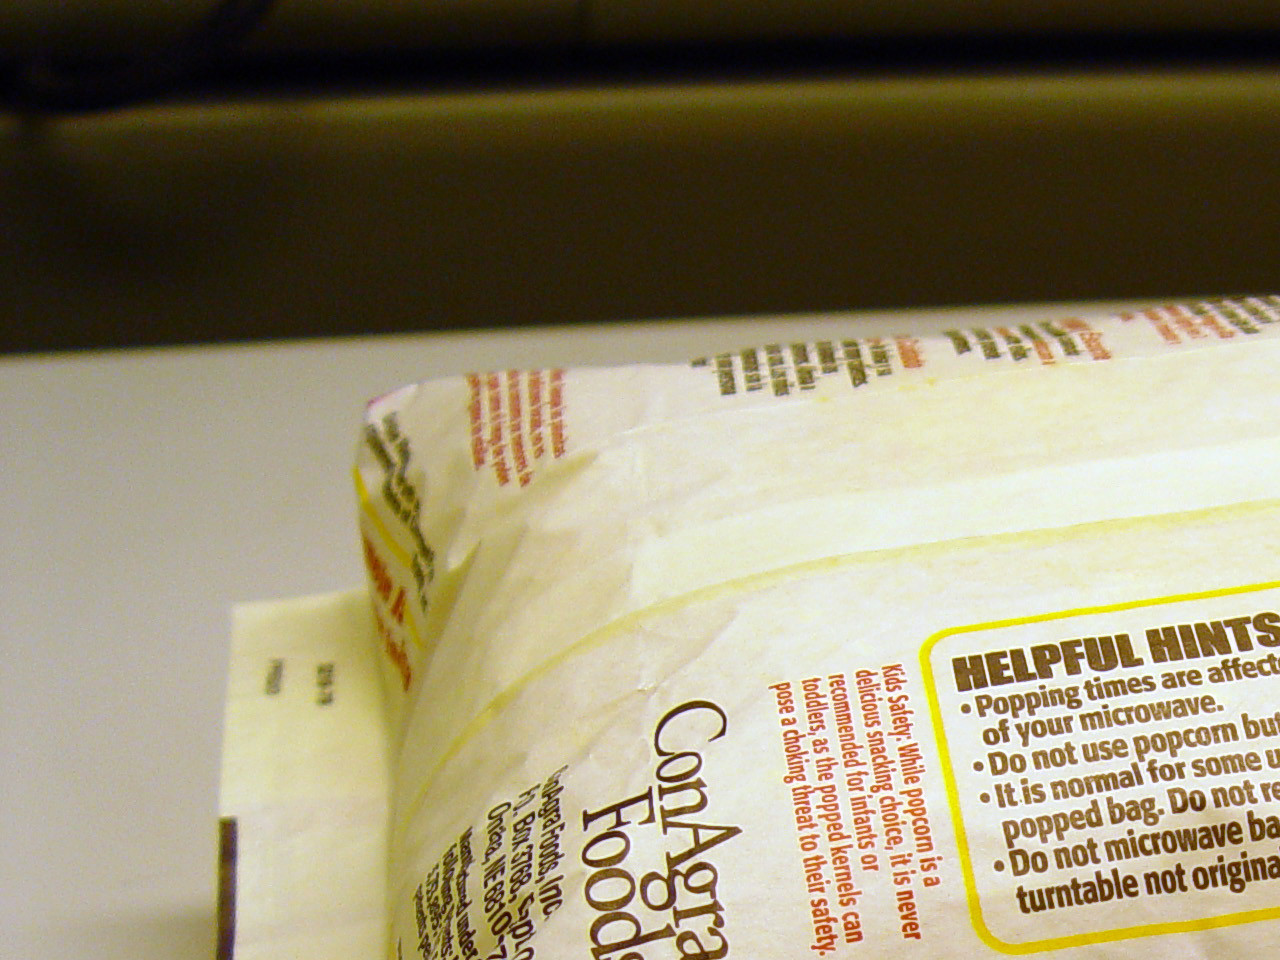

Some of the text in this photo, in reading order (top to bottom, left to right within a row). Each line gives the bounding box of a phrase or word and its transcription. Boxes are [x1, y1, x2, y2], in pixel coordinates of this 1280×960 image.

[952, 634, 1143, 691] HELPFUL
[975, 683, 1082, 719] Popping
[1083, 677, 1156, 702] times
[1161, 669, 1203, 690] are
[982, 693, 1224, 748] of your microwave.
[828, 673, 879, 871] recommended for infants or
[882, 663, 943, 887] Kids Safety: While popcorn is a
[988, 750, 1027, 776] Do
[1031, 739, 1078, 772] not
[1082, 735, 1128, 765] use
[1134, 723, 1240, 763] popcorn
[994, 782, 1018, 808] It
[1022, 779, 1046, 804] is
[1050, 762, 1143, 801] normal
[1146, 758, 1186, 784] for
[1191, 749, 1262, 779] some
[512, 810, 536, 852] Box
[768, 681, 839, 956] pose a choking threat to their safety.
[801, 677, 864, 943] toddlers, as the popped kernels can
[855, 669, 921, 940] delicious snacking choice, it is never
[1002, 802, 1109, 848] popped
[1110, 794, 1166, 826] bag.
[1170, 786, 1207, 814] Do
[1213, 775, 1257, 807] not
[535, 822, 566, 884] Foods,
[1008, 849, 1048, 877] Do
[1053, 840, 1100, 871] not
[1104, 818, 1243, 862] microwave
[538, 874, 565, 922] Inc.
[1016, 870, 1139, 914] turntable
[1145, 867, 1188, 896] not
